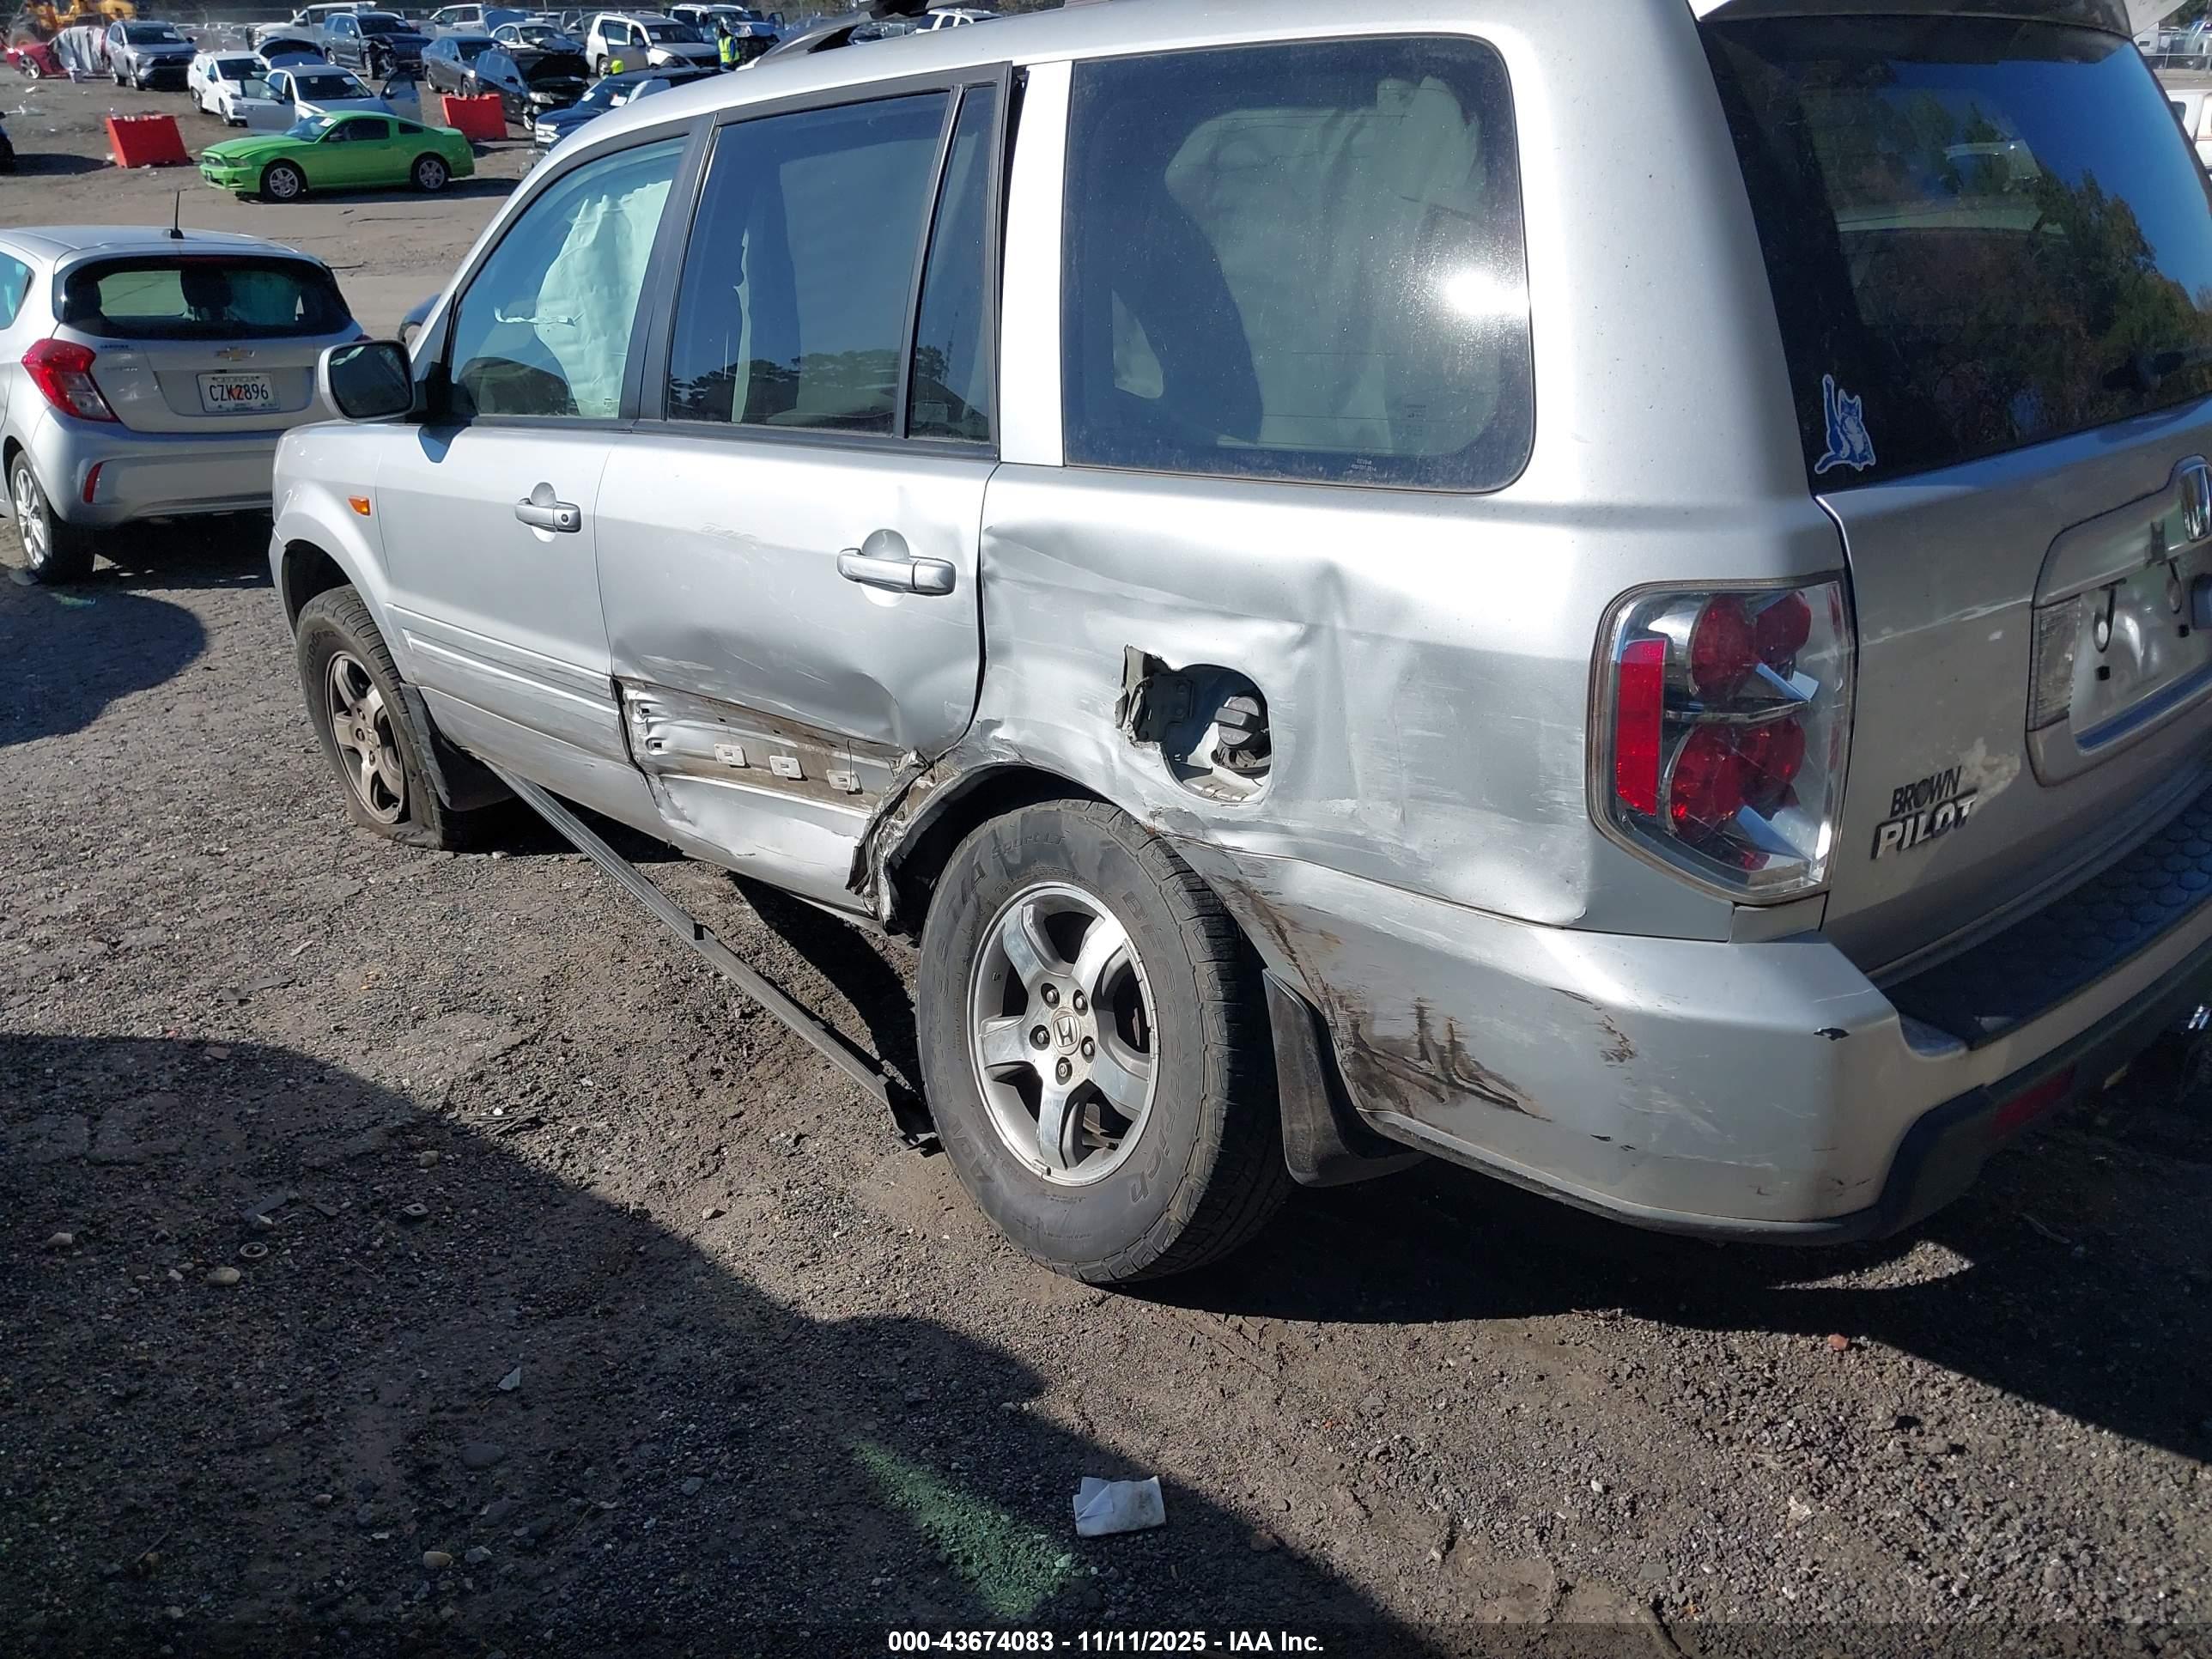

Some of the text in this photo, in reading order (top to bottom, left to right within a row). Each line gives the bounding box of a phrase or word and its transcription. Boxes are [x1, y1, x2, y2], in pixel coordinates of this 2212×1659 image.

[209, 383, 269, 402] CZK2896
[1890, 766, 1963, 818] BROWN
[1870, 787, 1978, 860] PILOT
